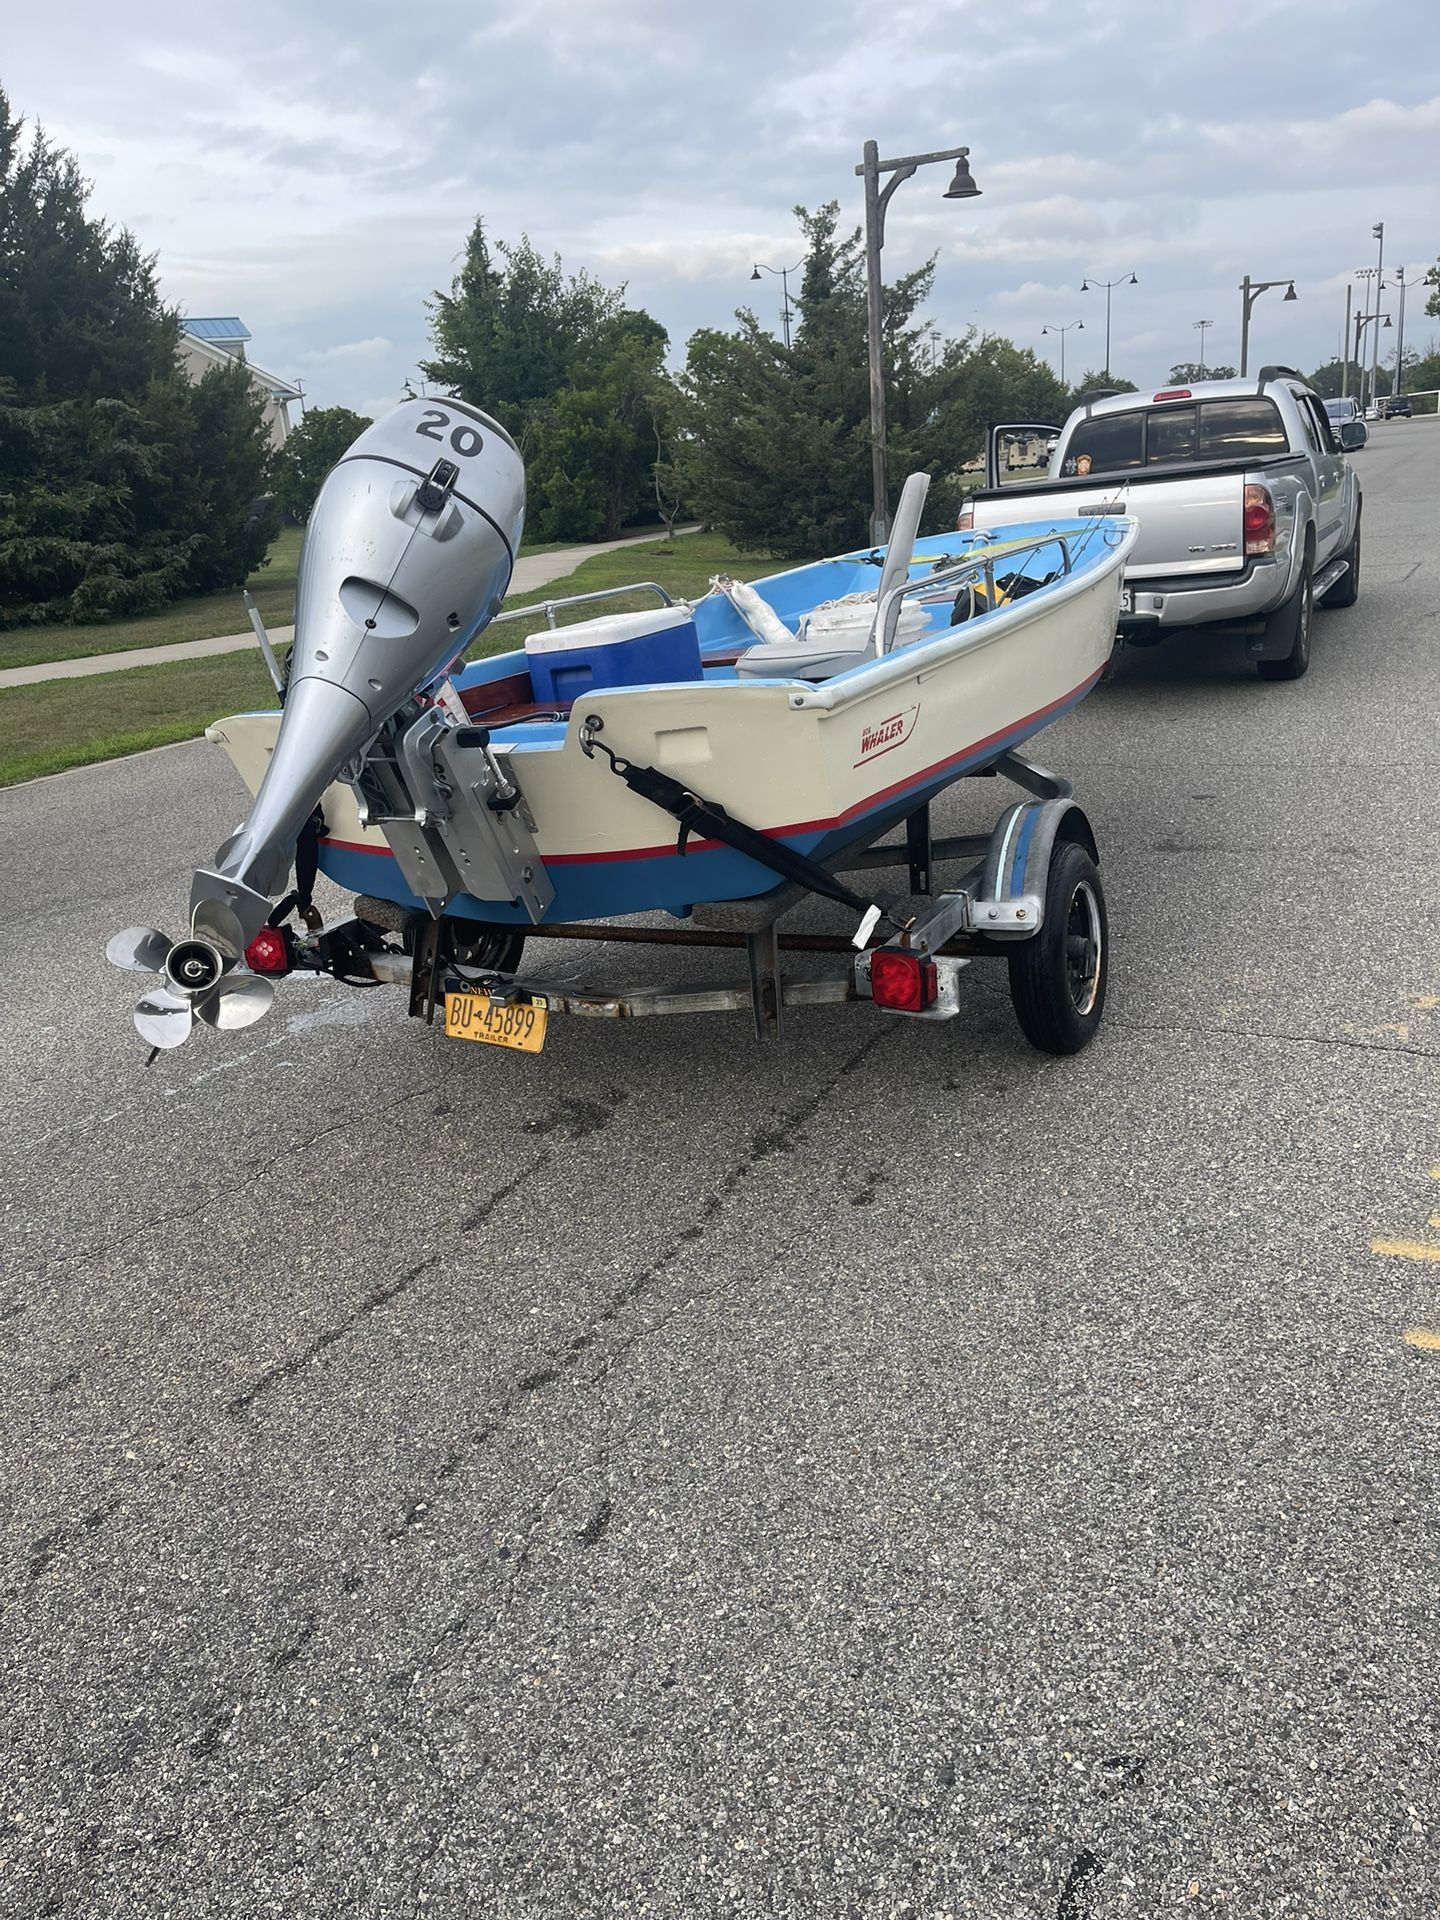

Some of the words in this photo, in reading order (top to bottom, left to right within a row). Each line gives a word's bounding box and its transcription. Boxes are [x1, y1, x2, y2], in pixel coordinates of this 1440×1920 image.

[416, 410, 484, 457] 20
[861, 719, 904, 754] WHALER
[474, 1031, 509, 1044] TRAILER
